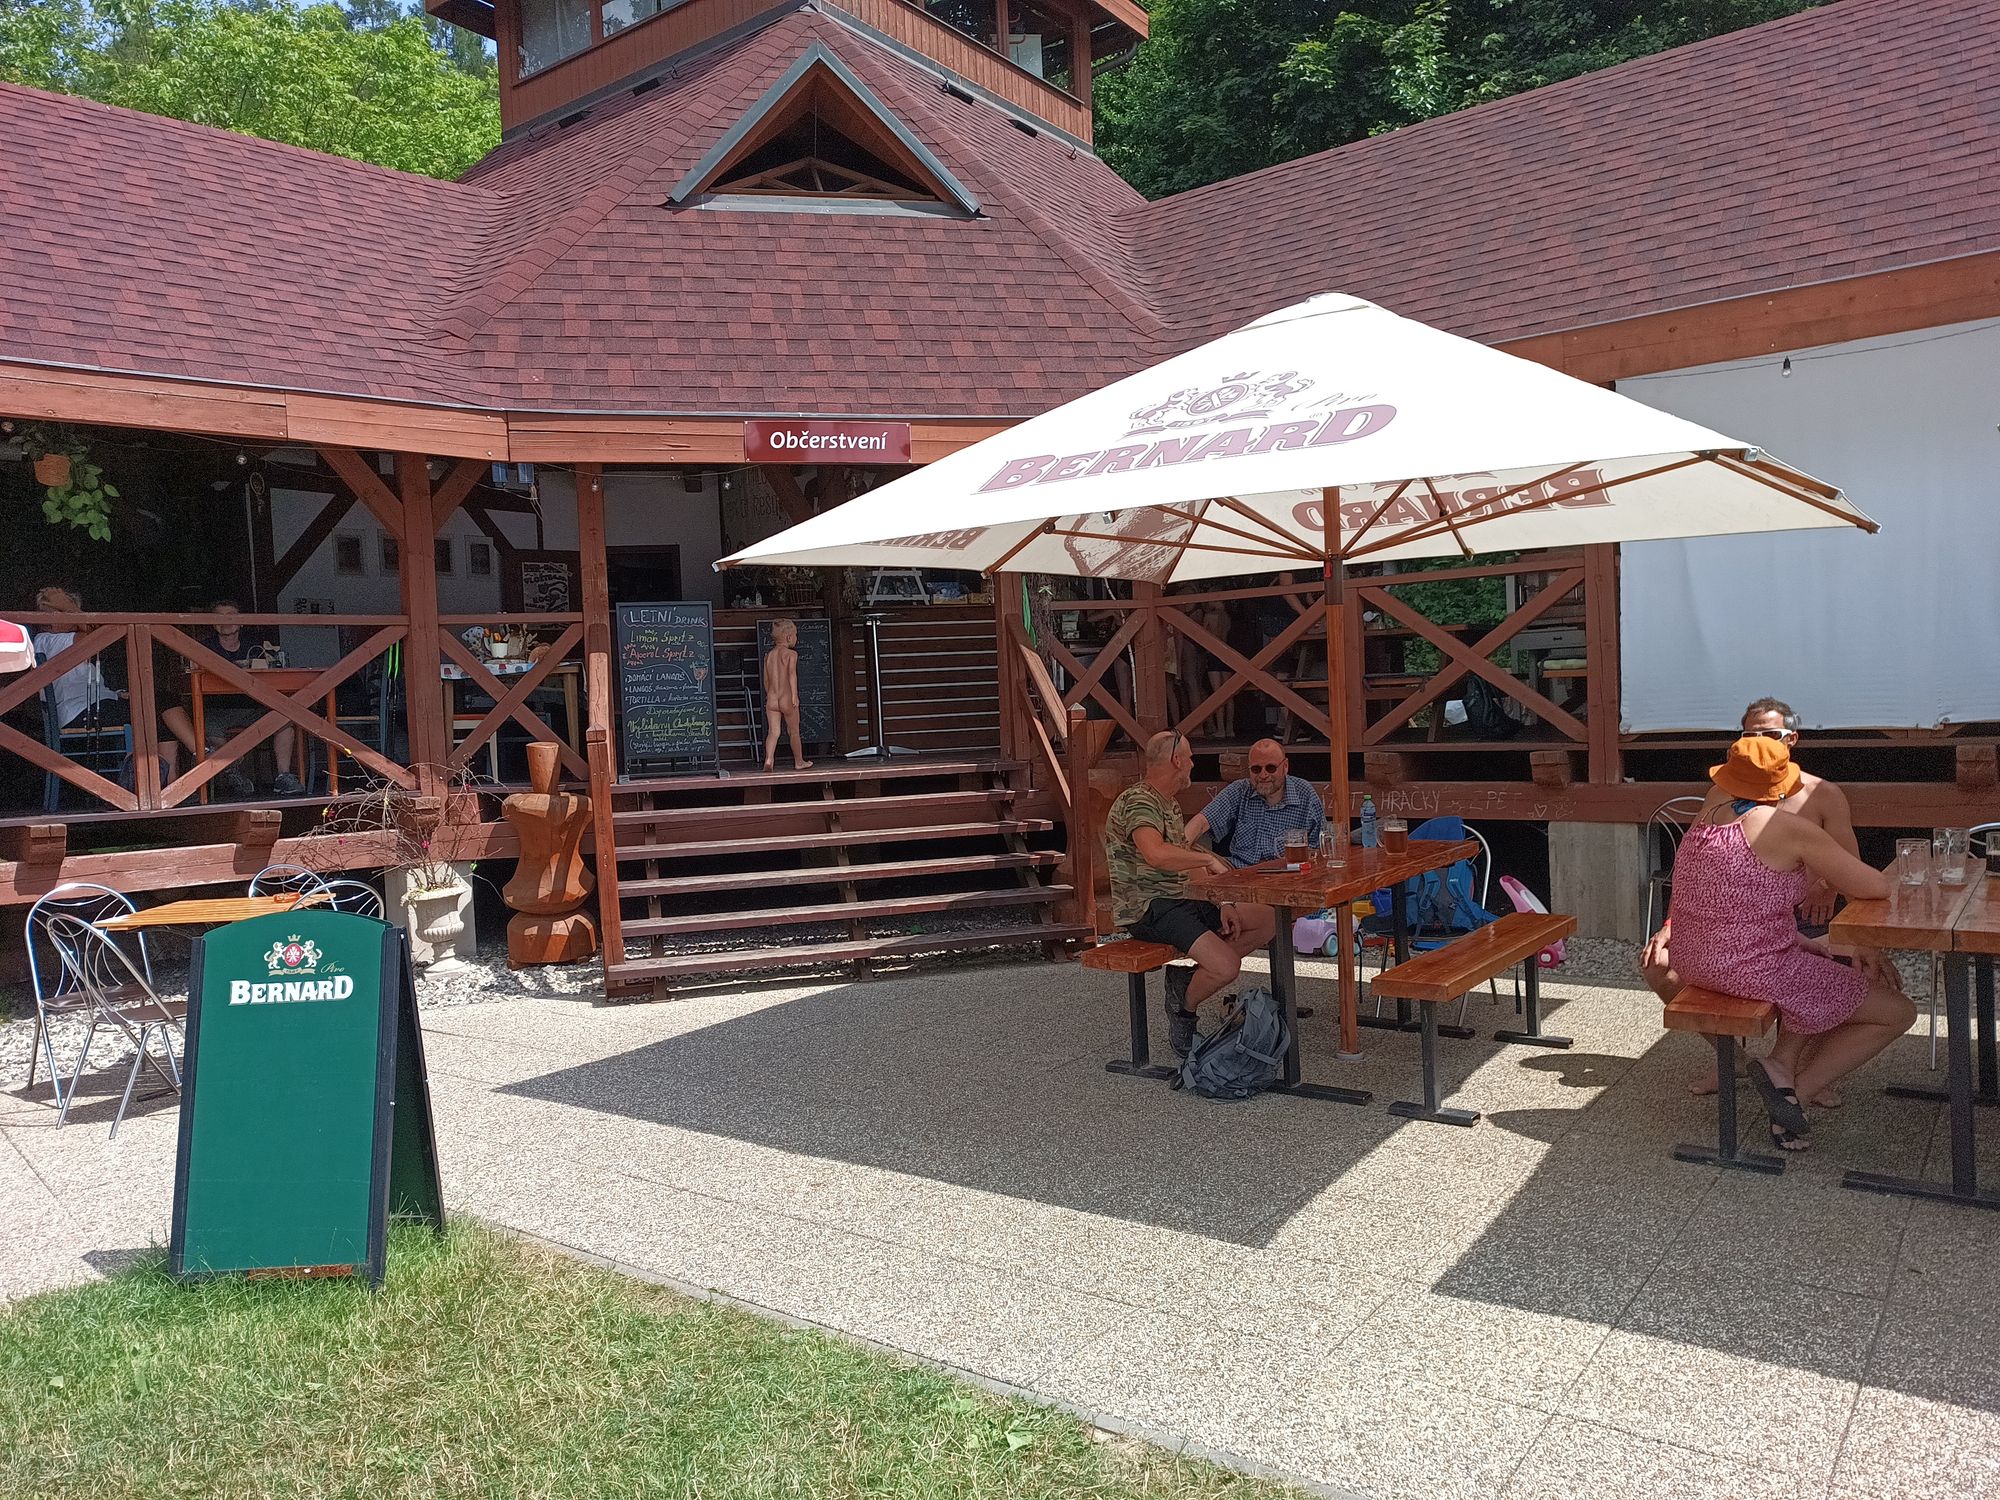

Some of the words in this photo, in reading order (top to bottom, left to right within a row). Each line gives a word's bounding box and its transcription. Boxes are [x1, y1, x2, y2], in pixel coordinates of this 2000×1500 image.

[770, 431, 888, 450] Občerstvení
[977, 404, 1398, 492] BERNARD
[630, 607, 676, 623] LETNÍ
[629, 695, 661, 704] TORTILLA
[1380, 785, 1441, 812] HRAČKY
[229, 975, 354, 1006] BERNARD
